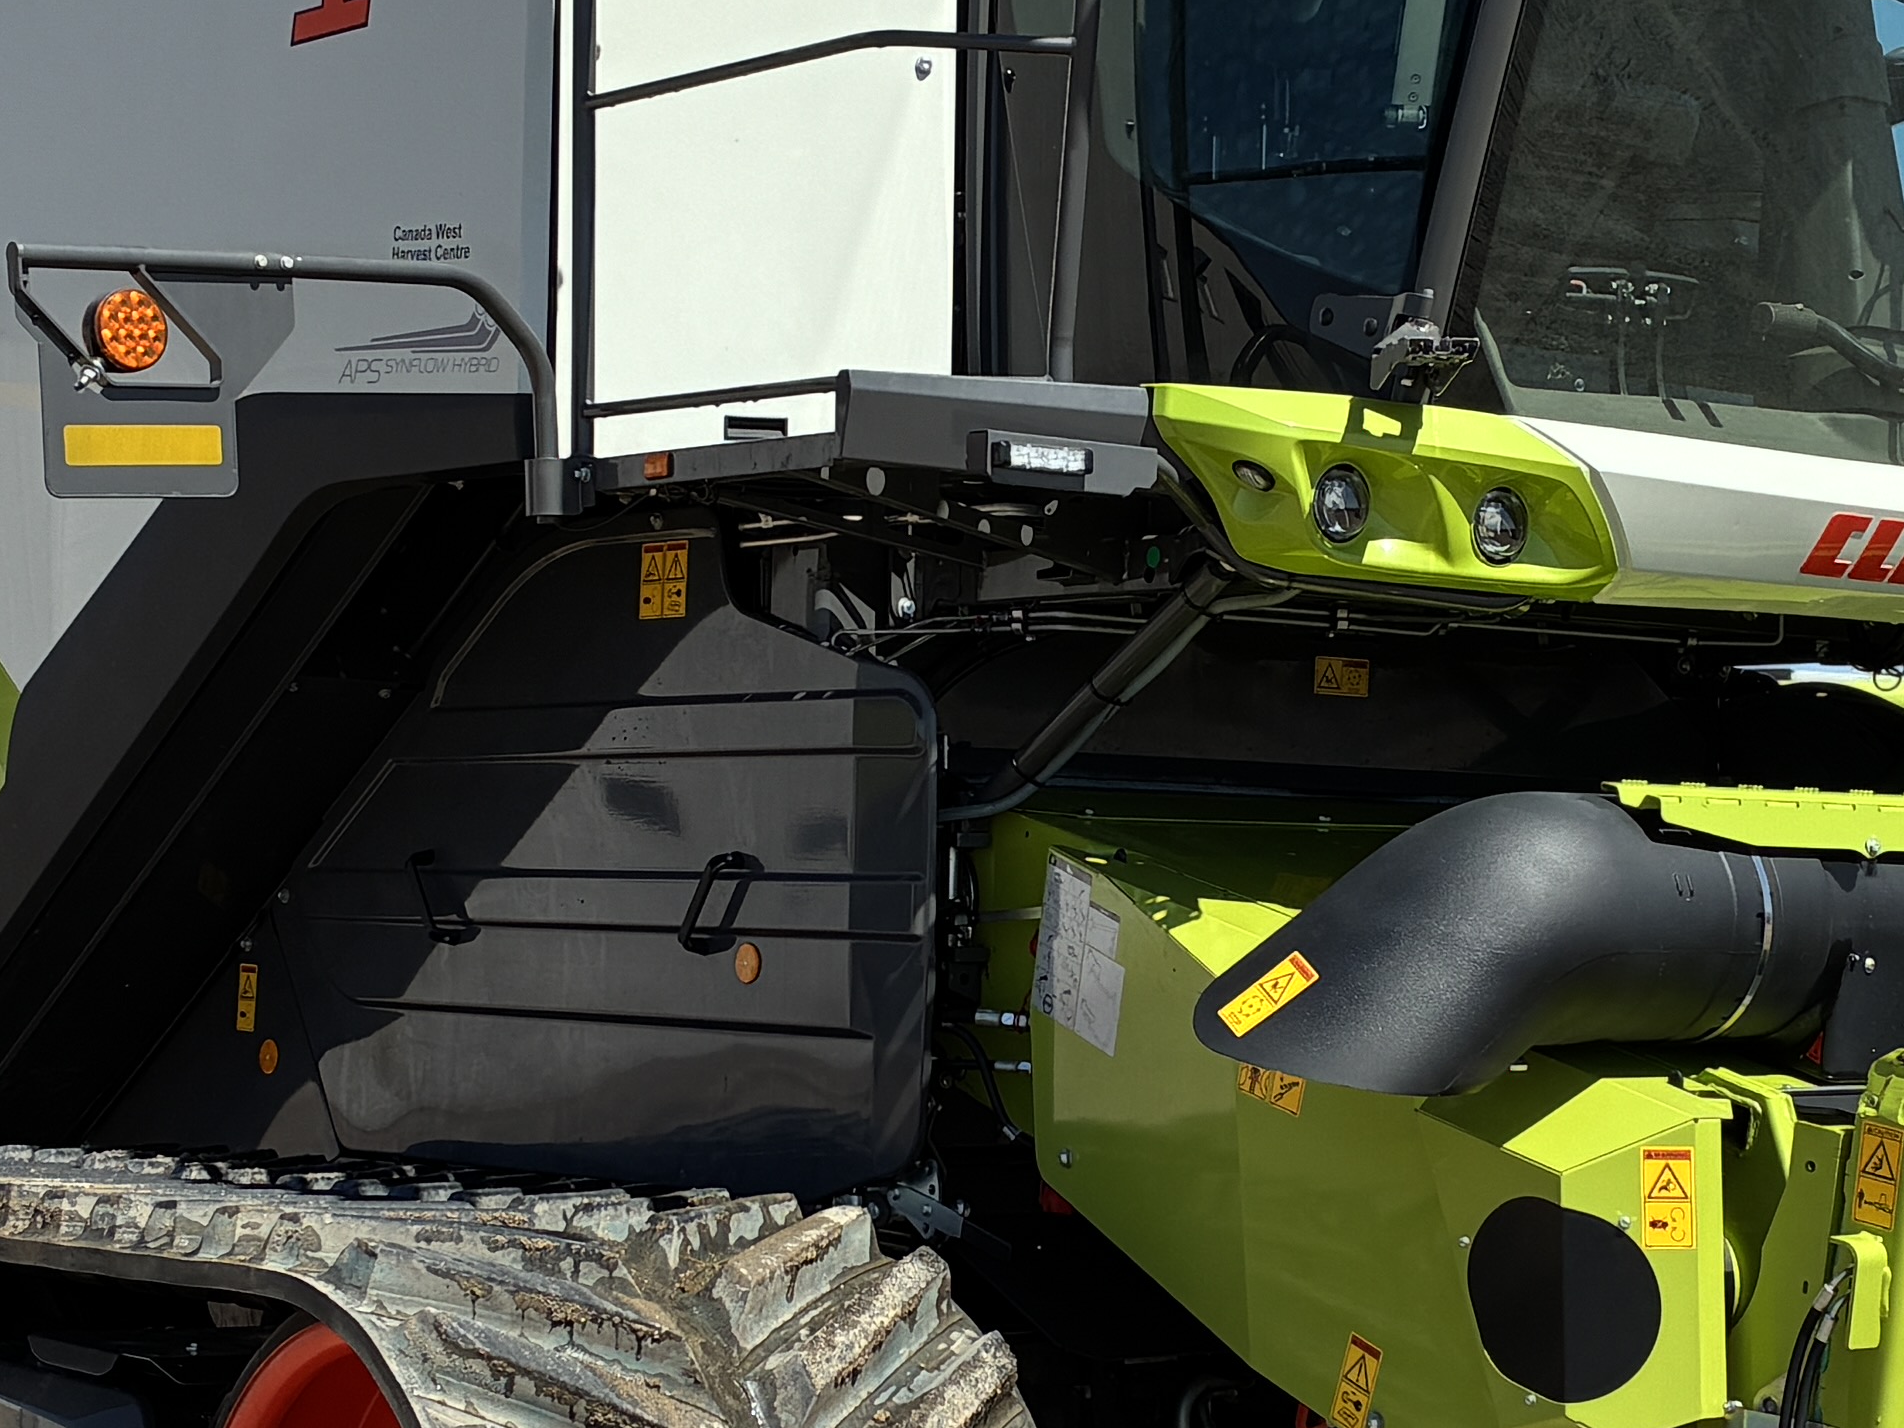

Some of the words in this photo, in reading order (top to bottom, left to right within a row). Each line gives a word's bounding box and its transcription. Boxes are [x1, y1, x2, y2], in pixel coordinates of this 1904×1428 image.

[393, 224, 433, 242] Canada
[435, 223, 462, 240] West
[392, 246, 433, 262] Harvest
[435, 243, 471, 261] Centre
[337, 358, 384, 385] APS
[384, 357, 451, 374] SYNFLOW
